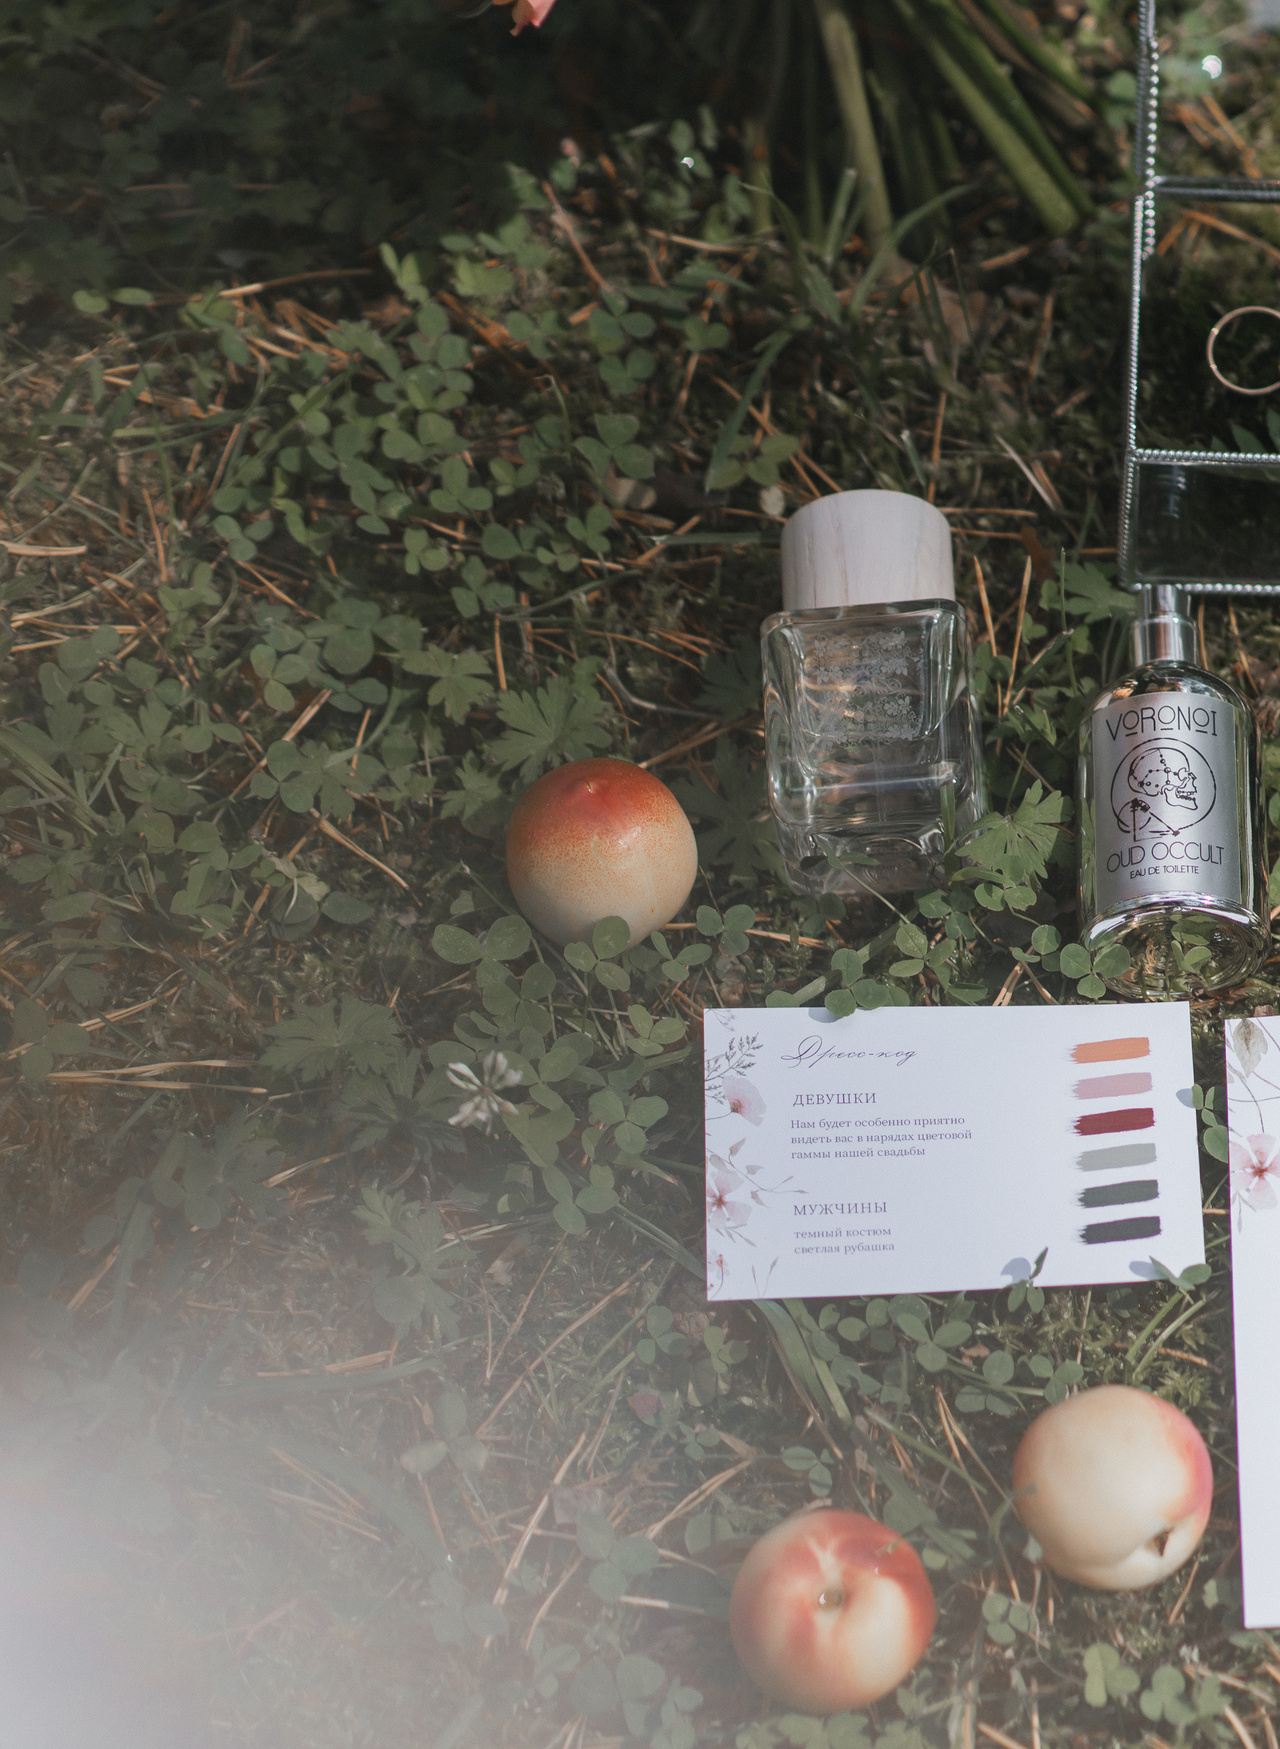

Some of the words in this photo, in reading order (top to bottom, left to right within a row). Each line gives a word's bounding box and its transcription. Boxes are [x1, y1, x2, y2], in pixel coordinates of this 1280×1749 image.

[1106, 705, 1218, 741] VORONOI
[1107, 845, 1146, 873] OUD
[1151, 841, 1224, 866] OCCULT
[1130, 867, 1147, 879] EAU
[1148, 866, 1160, 875] DE
[1163, 864, 1199, 875] TOILETTE
[780, 1034, 917, 1069] Дресс-код
[792, 1092, 877, 1108] ДЕВУШКИ
[790, 1118, 816, 1130] Нам
[818, 1117, 852, 1131] будет
[854, 1116, 911, 1129] особенно
[913, 1116, 966, 1129] приятно
[790, 1134, 832, 1145] видеть
[834, 1134, 854, 1144] вас
[856, 1134, 864, 1143] в
[866, 1132, 915, 1145] нарядах
[917, 1129, 973, 1143] цветовой
[790, 1149, 832, 1160] гаммы
[834, 1146, 875, 1158] нашей
[877, 1145, 926, 1157] свадьбы
[793, 1201, 888, 1216] МУЖЧИНЫ
[793, 1226, 843, 1239] темный
[845, 1227, 893, 1238] костюм
[794, 1244, 841, 1255] светлая
[843, 1241, 896, 1255] рубашка
